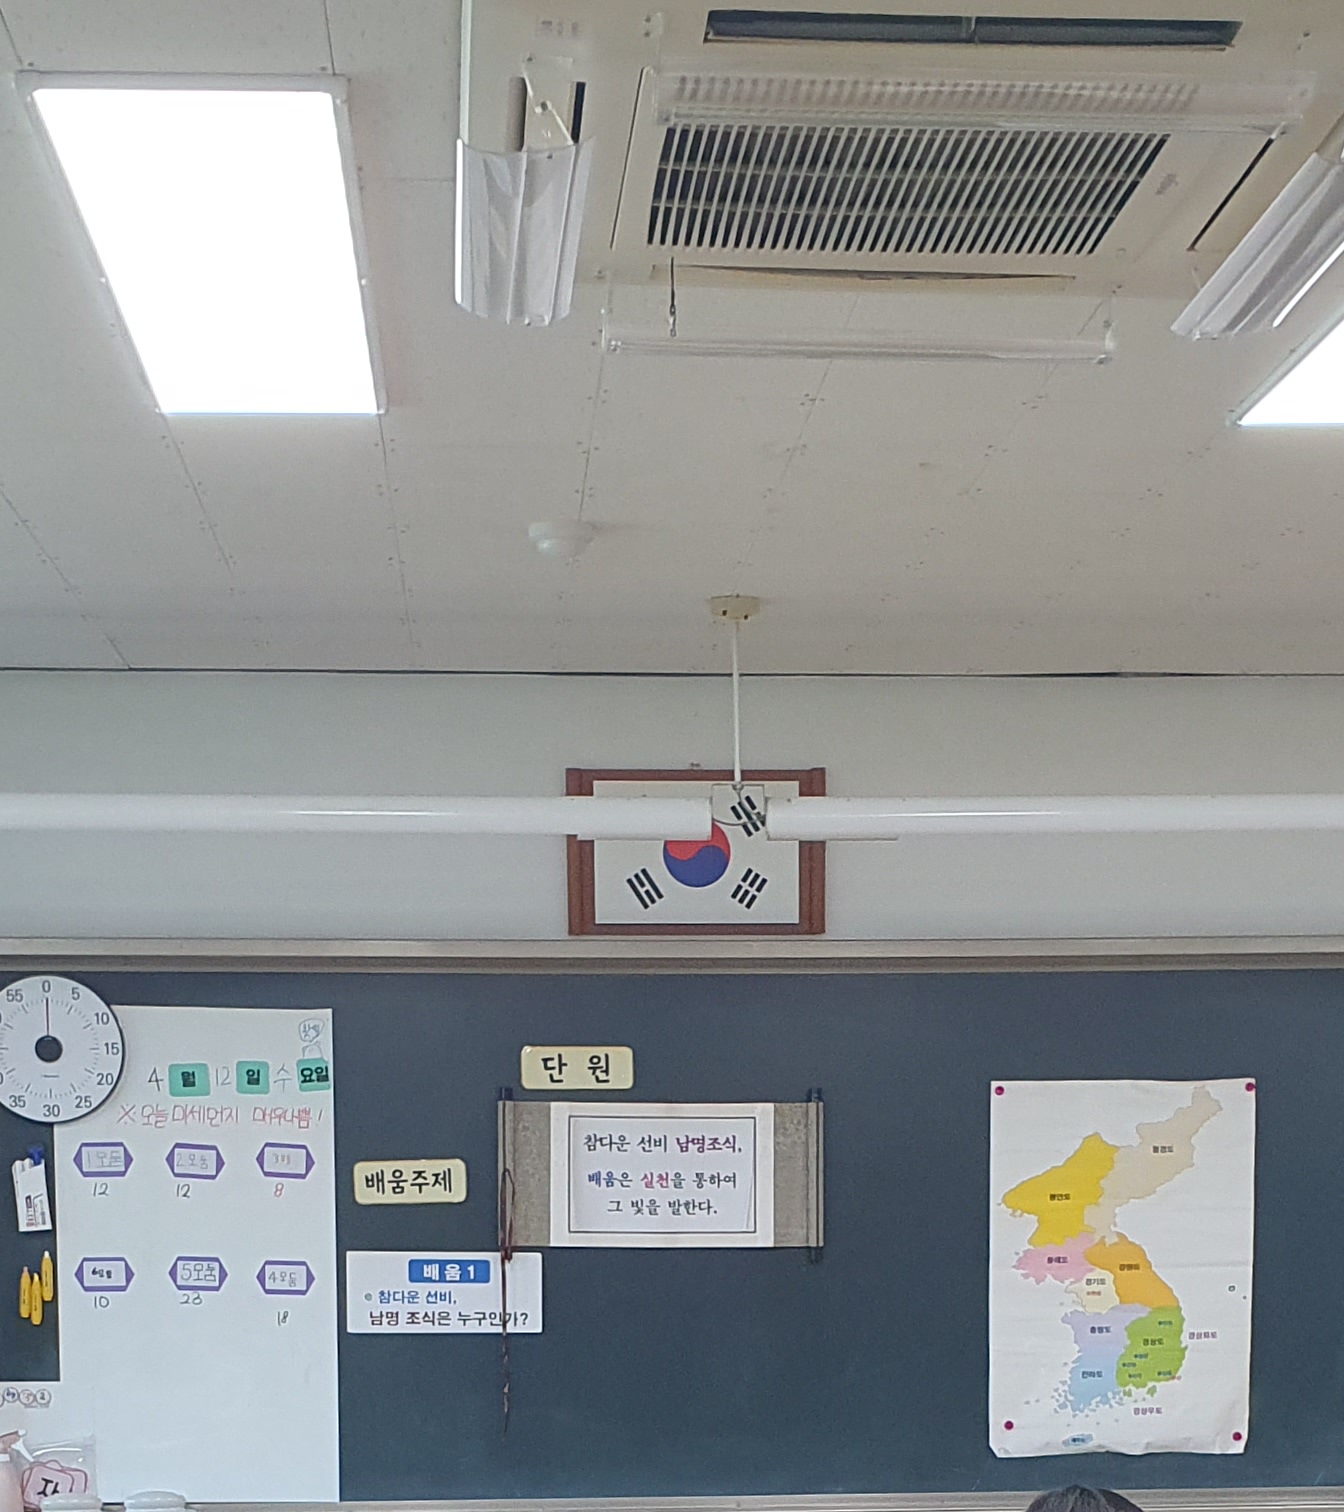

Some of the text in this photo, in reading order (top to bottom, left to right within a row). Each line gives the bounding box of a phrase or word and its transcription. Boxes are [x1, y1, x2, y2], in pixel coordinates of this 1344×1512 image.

[41, 980, 51, 993] 0
[71, 987, 80, 1000] 5
[6, 989, 24, 1002] 55
[94, 1012, 110, 1025] 10
[104, 1042, 120, 1055] 15
[96, 1073, 114, 1086] 20
[147, 1067, 164, 1092] 4
[181, 1071, 196, 1088] 월
[215, 1066, 232, 1087] 12
[245, 1069, 261, 1086] 일
[300, 1066, 330, 1084] 요일
[9, 1095, 26, 1108] 35
[74, 1096, 92, 1109] 25
[42, 1104, 60, 1118] 30
[583, 1134, 743, 1154] 참다운 선비 남명조식,
[364, 1167, 453, 1196] 배움주제
[587, 1171, 738, 1190] 배움은 실천을 통하여
[92, 1183, 109, 1197] 12
[176, 1184, 191, 1198] 12
[273, 1183, 284, 1197] 8
[608, 1198, 719, 1217] 그 빛을 발한다.
[94, 1296, 109, 1309] 10
[378, 1290, 457, 1306] 참다운 선비,
[277, 1311, 288, 1326] 18
[369, 1310, 529, 1328] 남명 조식은 누구인가?
